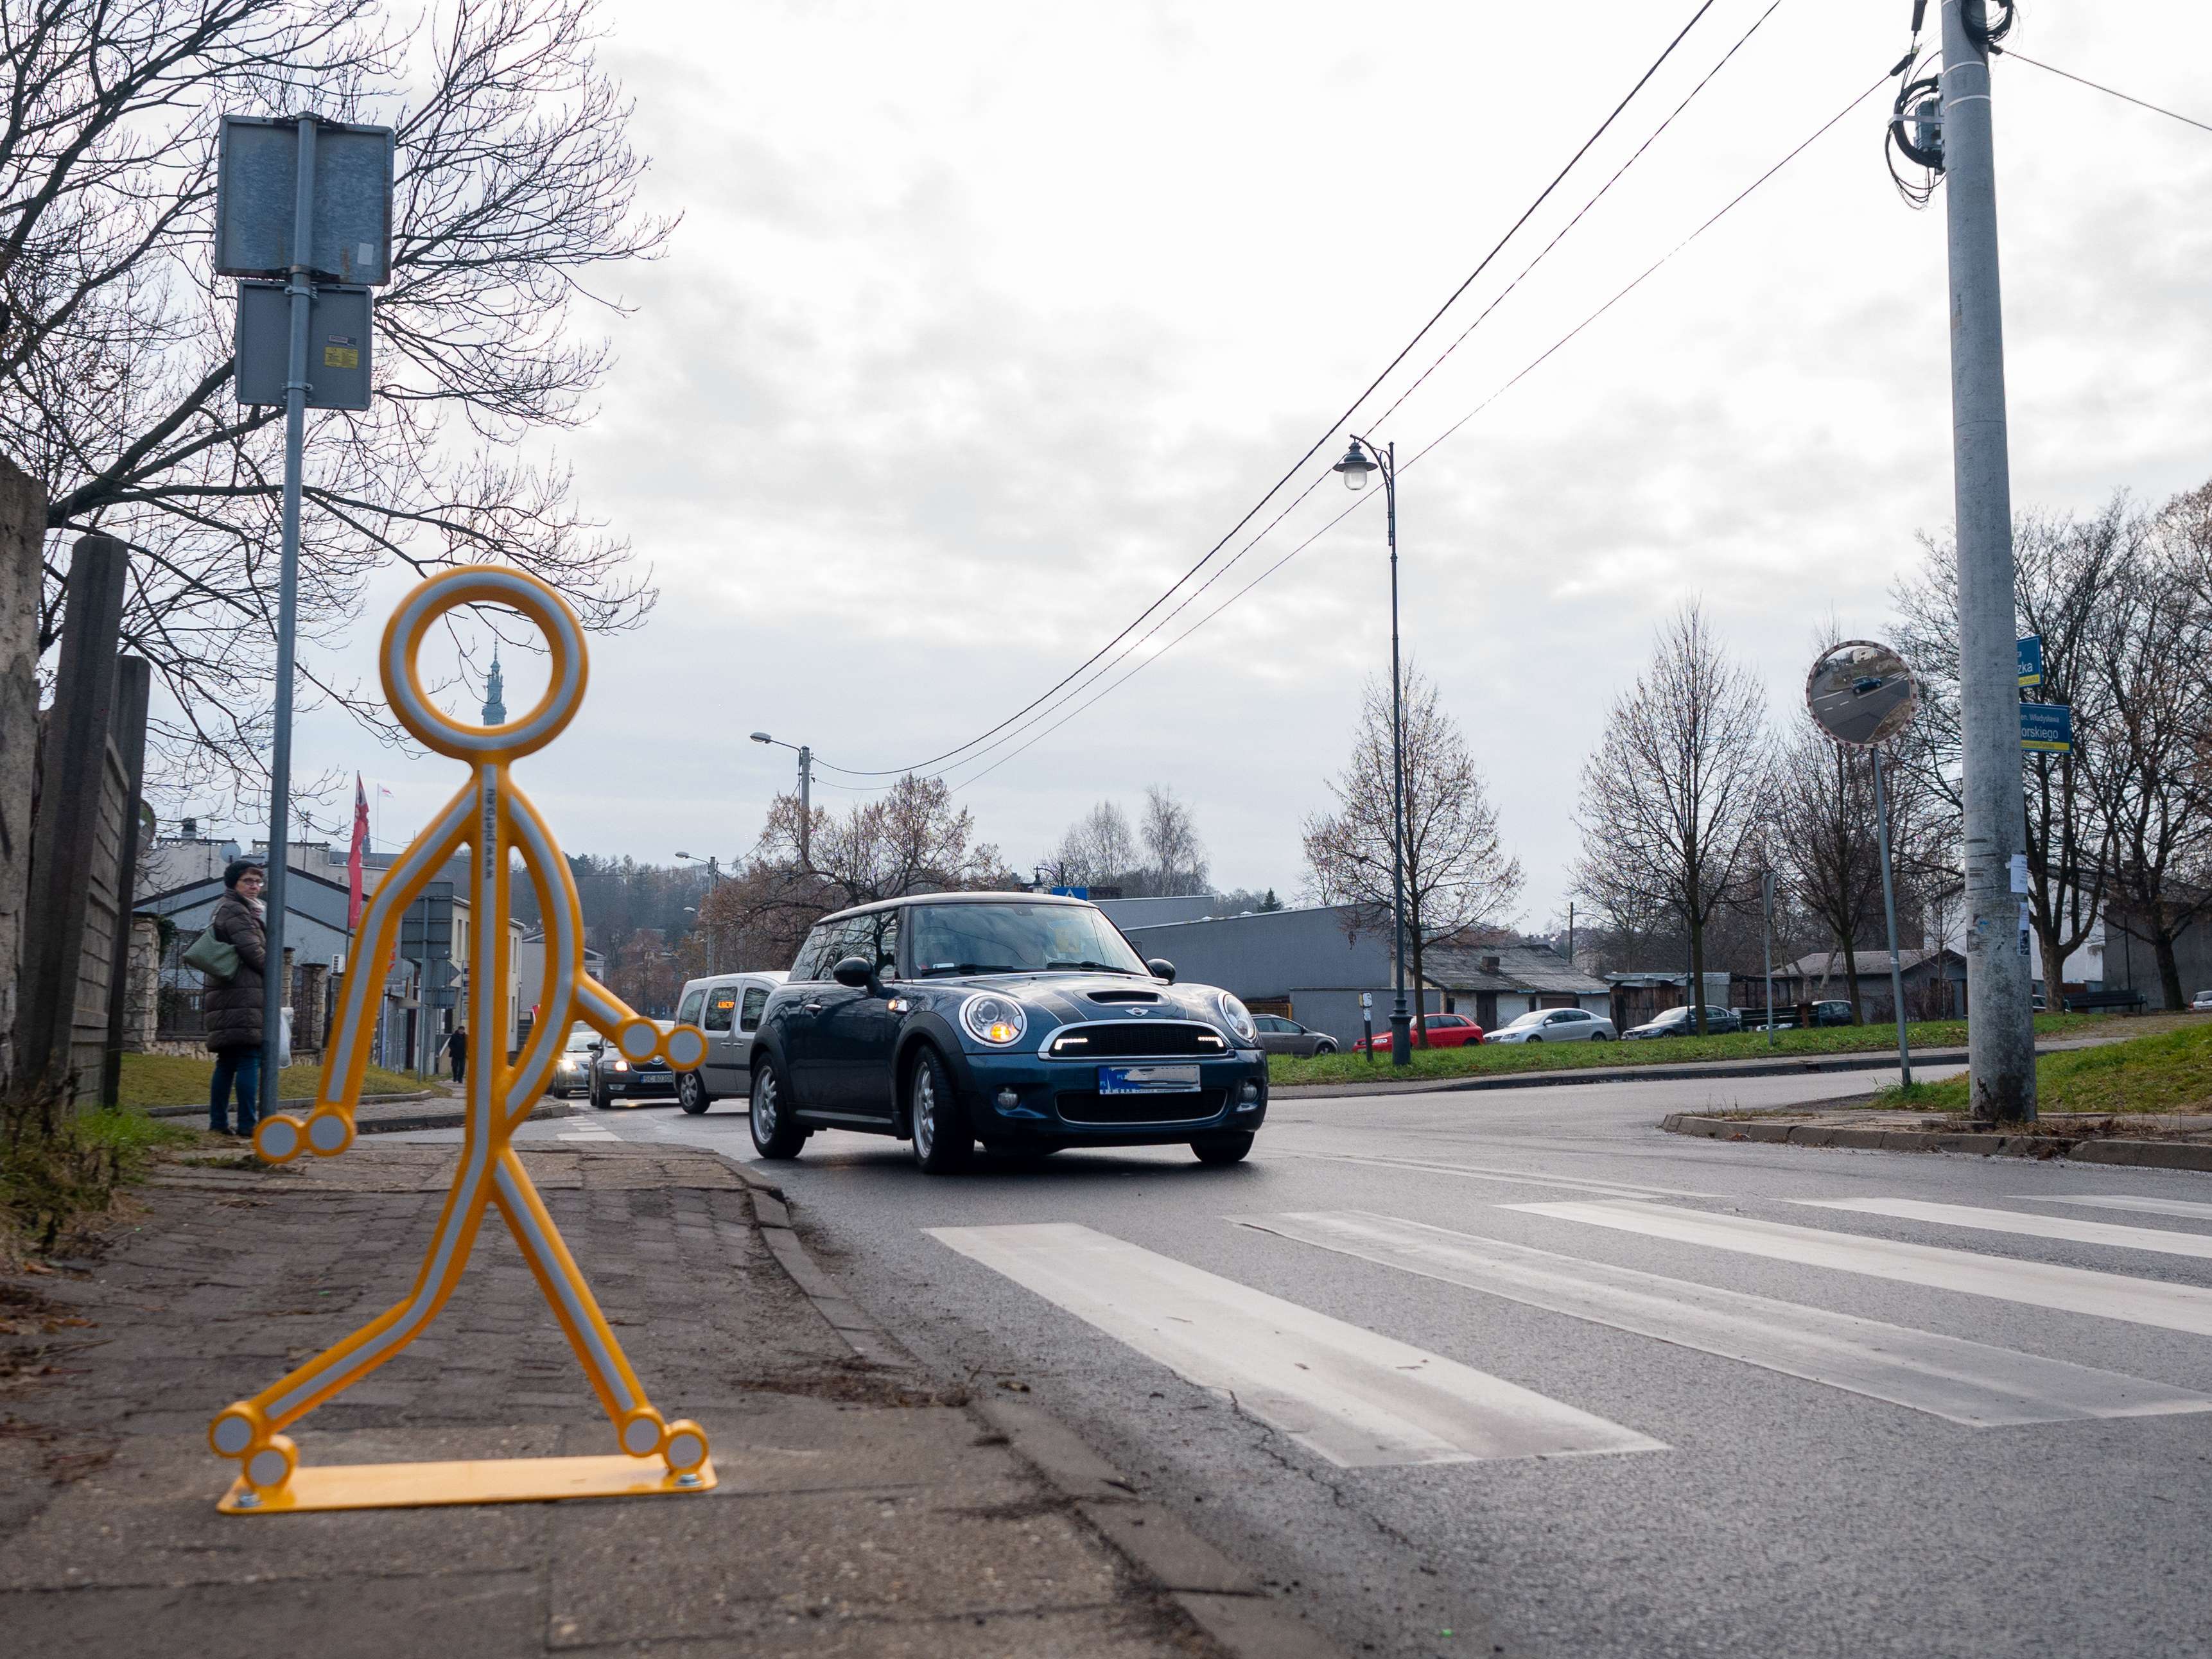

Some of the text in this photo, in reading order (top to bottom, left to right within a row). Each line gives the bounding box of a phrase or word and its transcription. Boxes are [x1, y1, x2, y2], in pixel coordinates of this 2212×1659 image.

[2017, 661, 2033, 674] zka
[2021, 725, 2059, 741] orskiego
[483, 788, 498, 880] www.pieto.eu
